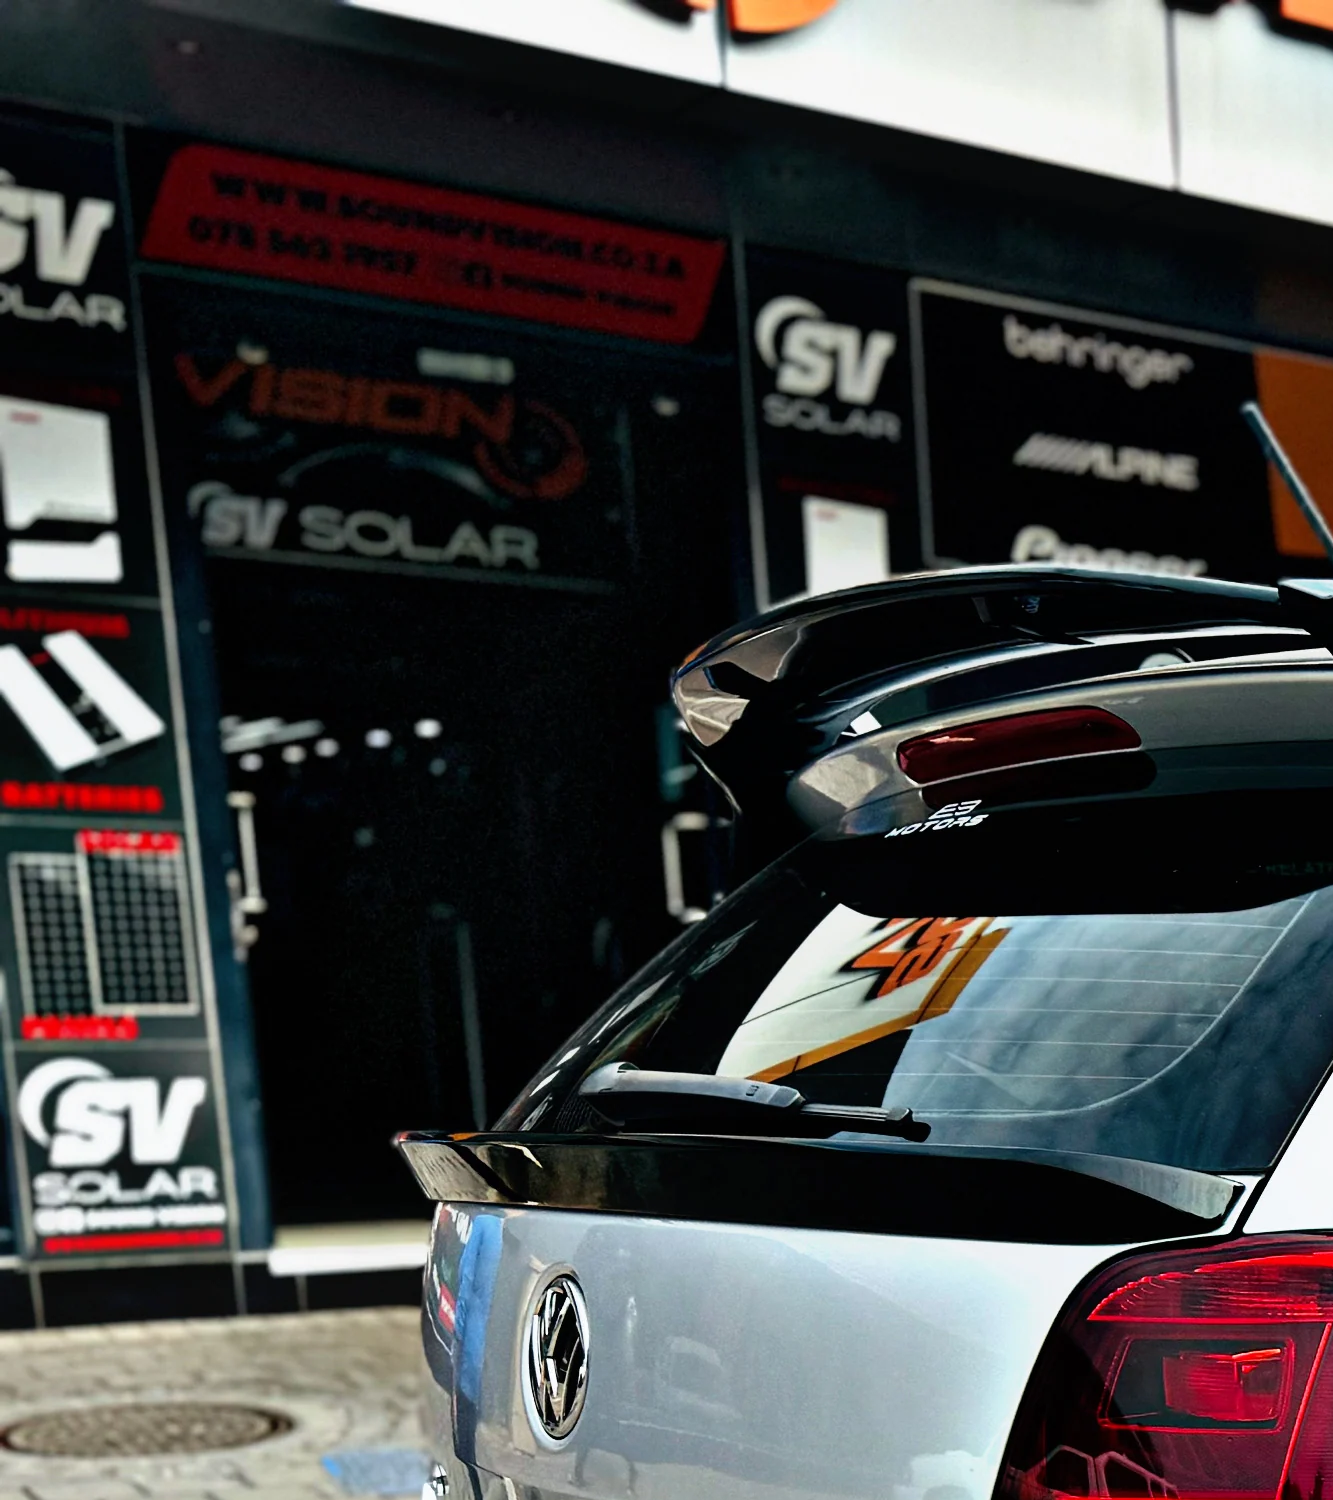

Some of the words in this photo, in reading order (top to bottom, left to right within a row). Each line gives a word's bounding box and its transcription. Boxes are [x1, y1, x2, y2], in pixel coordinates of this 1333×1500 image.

[776, 319, 898, 405] SV
[1002, 314, 1194, 389] behringer
[172, 349, 517, 446] VISION
[763, 393, 902, 442] SOLAR
[199, 494, 291, 552] SV
[297, 503, 541, 572] SOLAR
[884, 814, 990, 838] MOTORS
[49, 1077, 207, 1167] SV
[33, 1165, 219, 1207] SOLAR
